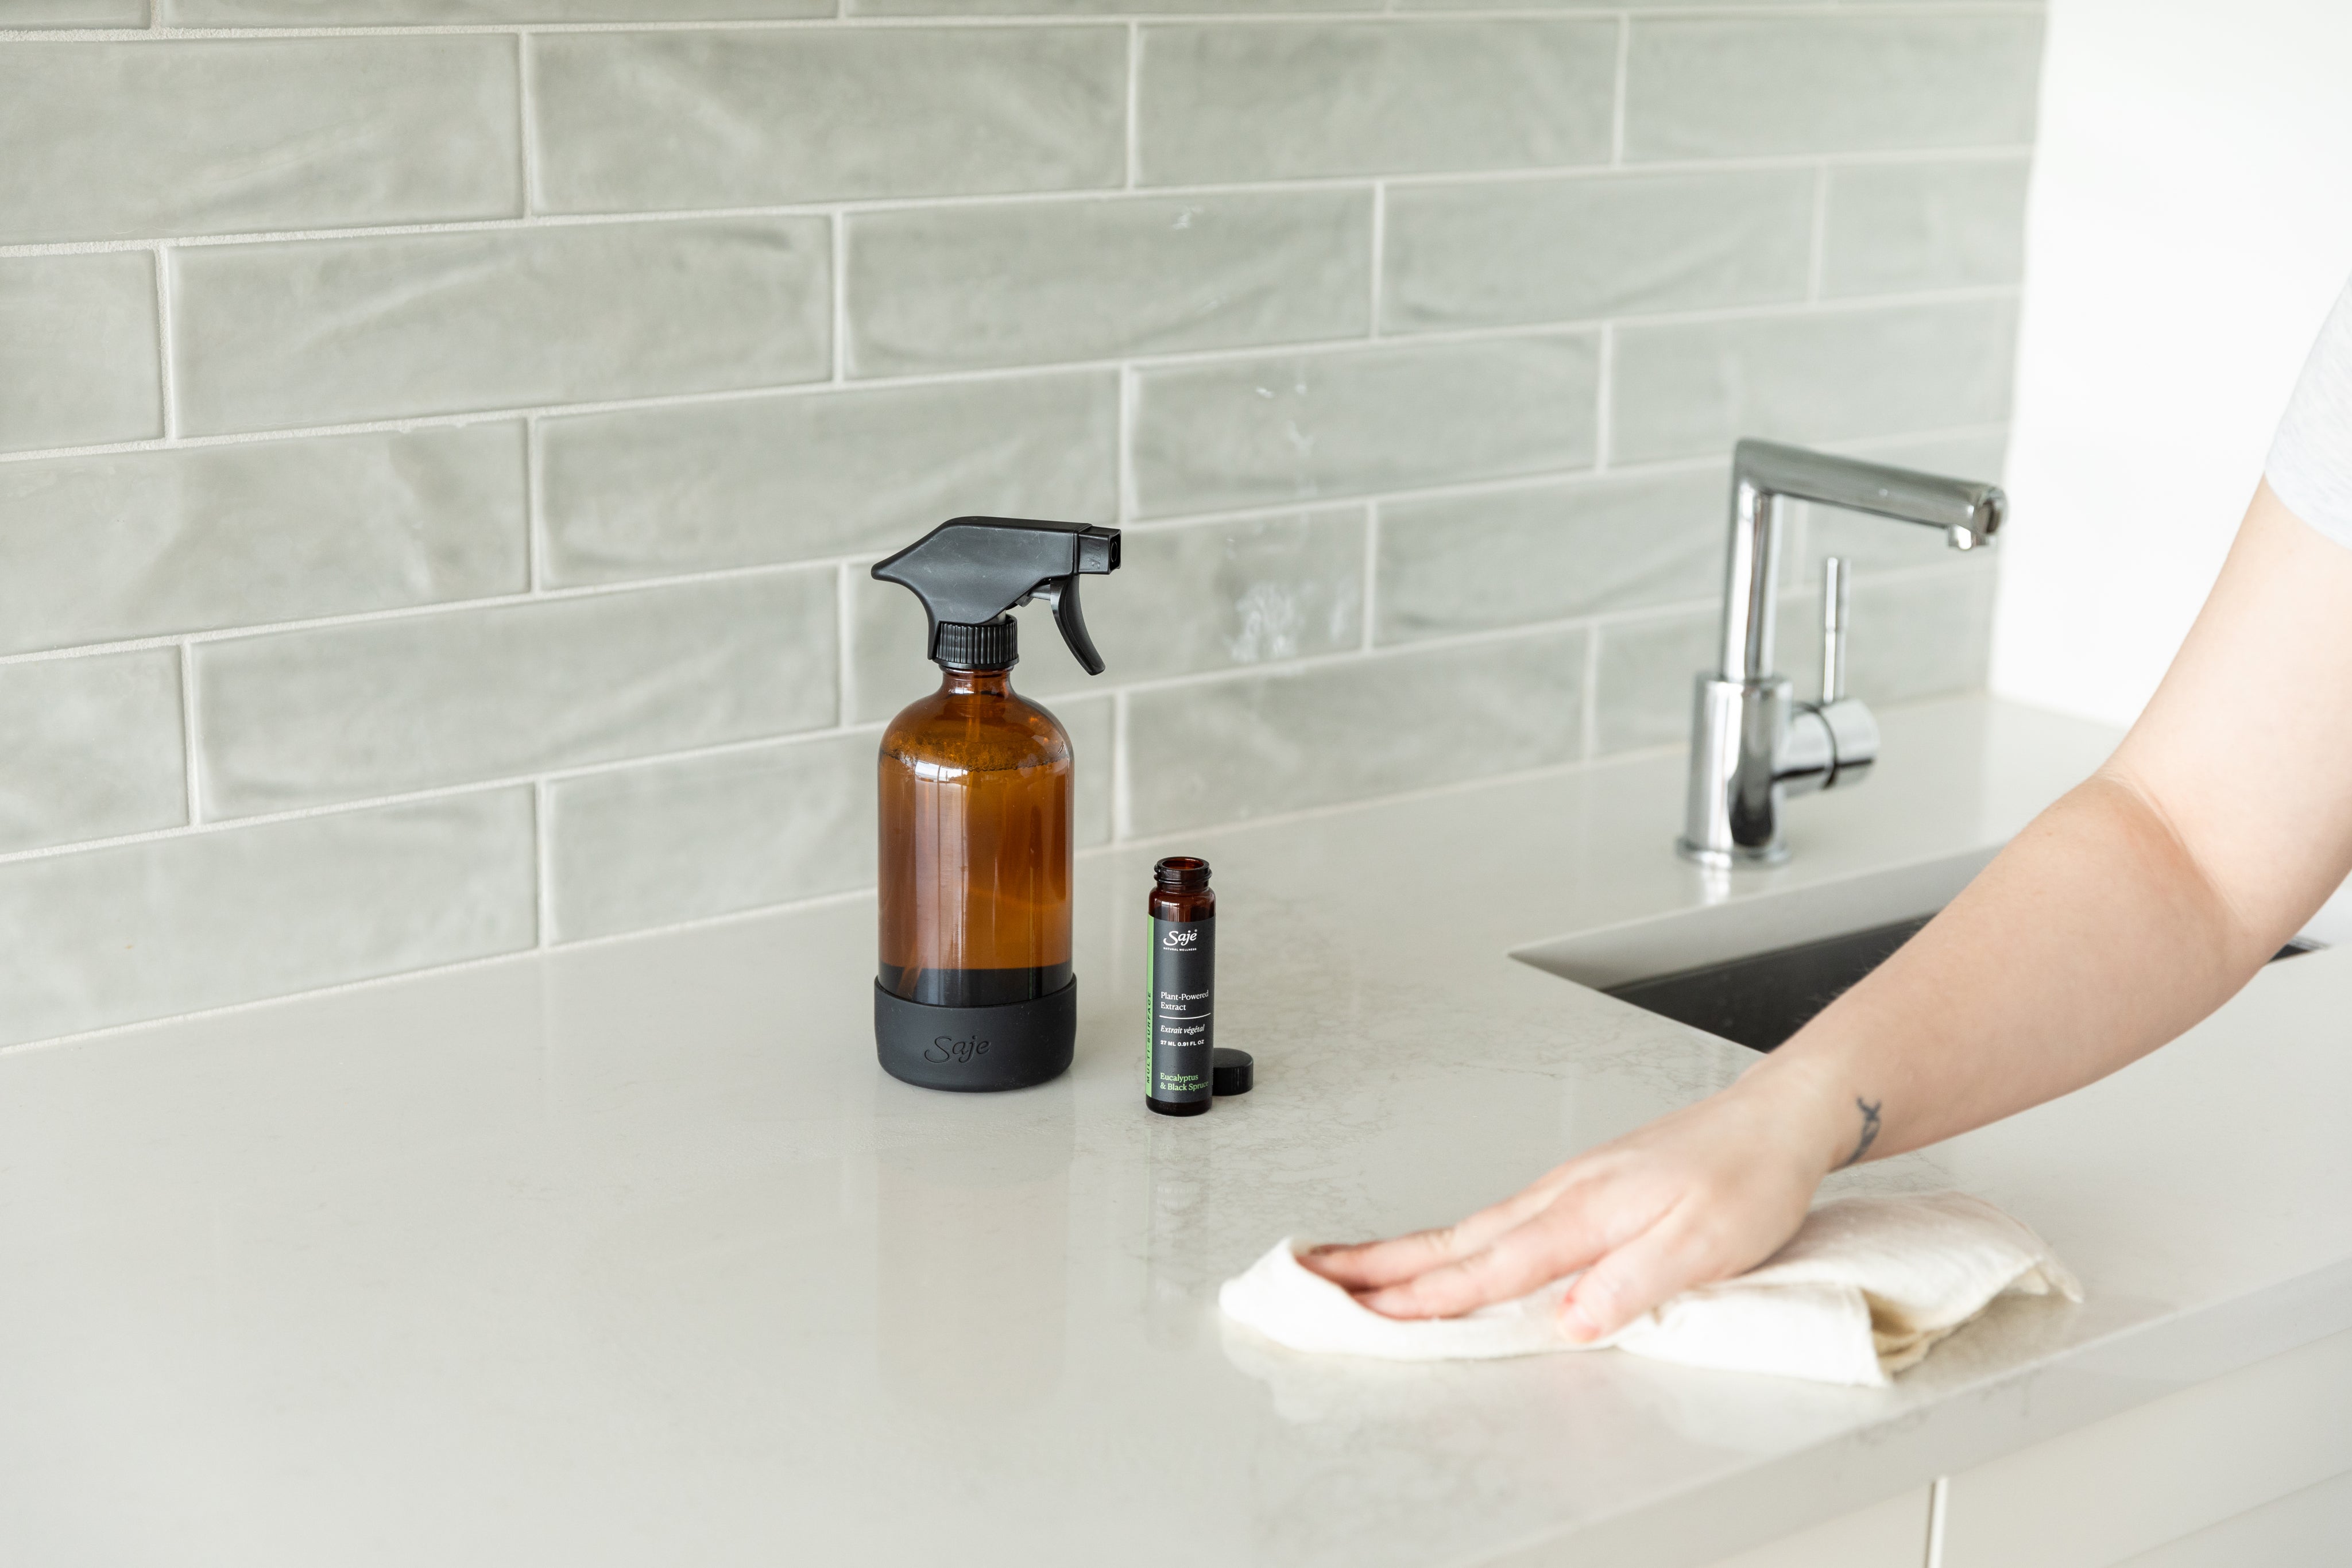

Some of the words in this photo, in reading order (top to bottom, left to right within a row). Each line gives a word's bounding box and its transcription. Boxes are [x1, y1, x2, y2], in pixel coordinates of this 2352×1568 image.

[1163, 929, 1198, 946] Saje
[1160, 989, 1209, 1001] Plant-Powered
[1160, 1001, 1186, 1011] Extract
[1160, 1025, 1183, 1034] Extrait
[1183, 1024, 1205, 1035] végétal
[924, 1035, 992, 1063] Saje
[1160, 1073, 1198, 1083] Eucalyptus
[1167, 1083, 1187, 1091] Black
[1188, 1081, 1209, 1092] Spruce
